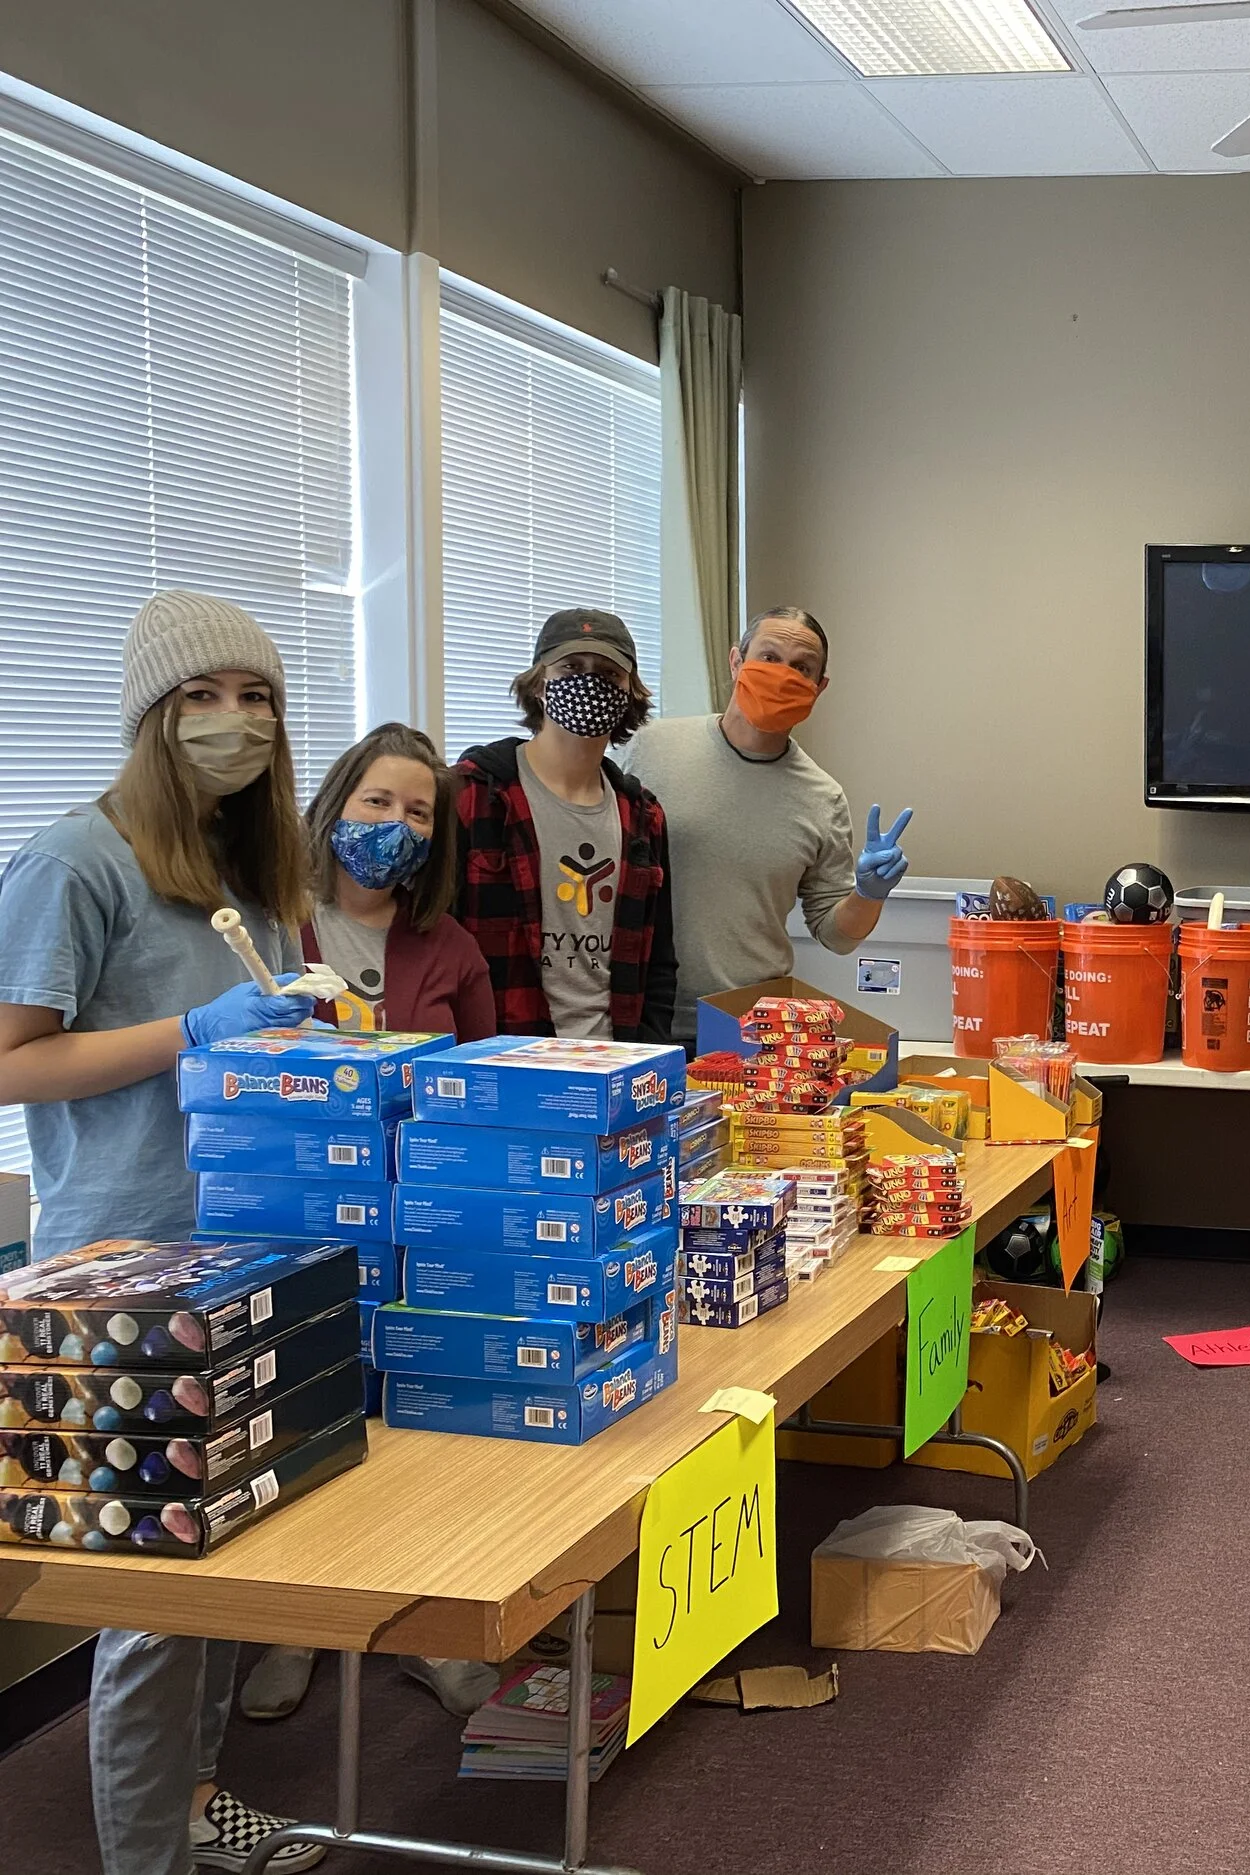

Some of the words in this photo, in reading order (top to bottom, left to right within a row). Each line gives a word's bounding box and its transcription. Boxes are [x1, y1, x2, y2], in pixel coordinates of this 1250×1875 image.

[1070, 969, 1112, 983] DOING:
[953, 1015, 983, 1031] PEAT
[1065, 1019, 1110, 1037] EPEAT
[883, 1166, 906, 1178] UNO
[883, 1178, 906, 1190] UNO
[888, 1190, 911, 1203] UNO
[881, 1202, 901, 1213] UNO
[883, 1213, 905, 1225] UNO
[872, 1225, 893, 1235] UNO
[918, 1295, 965, 1397] Family
[653, 1483, 763, 1650] STEM
